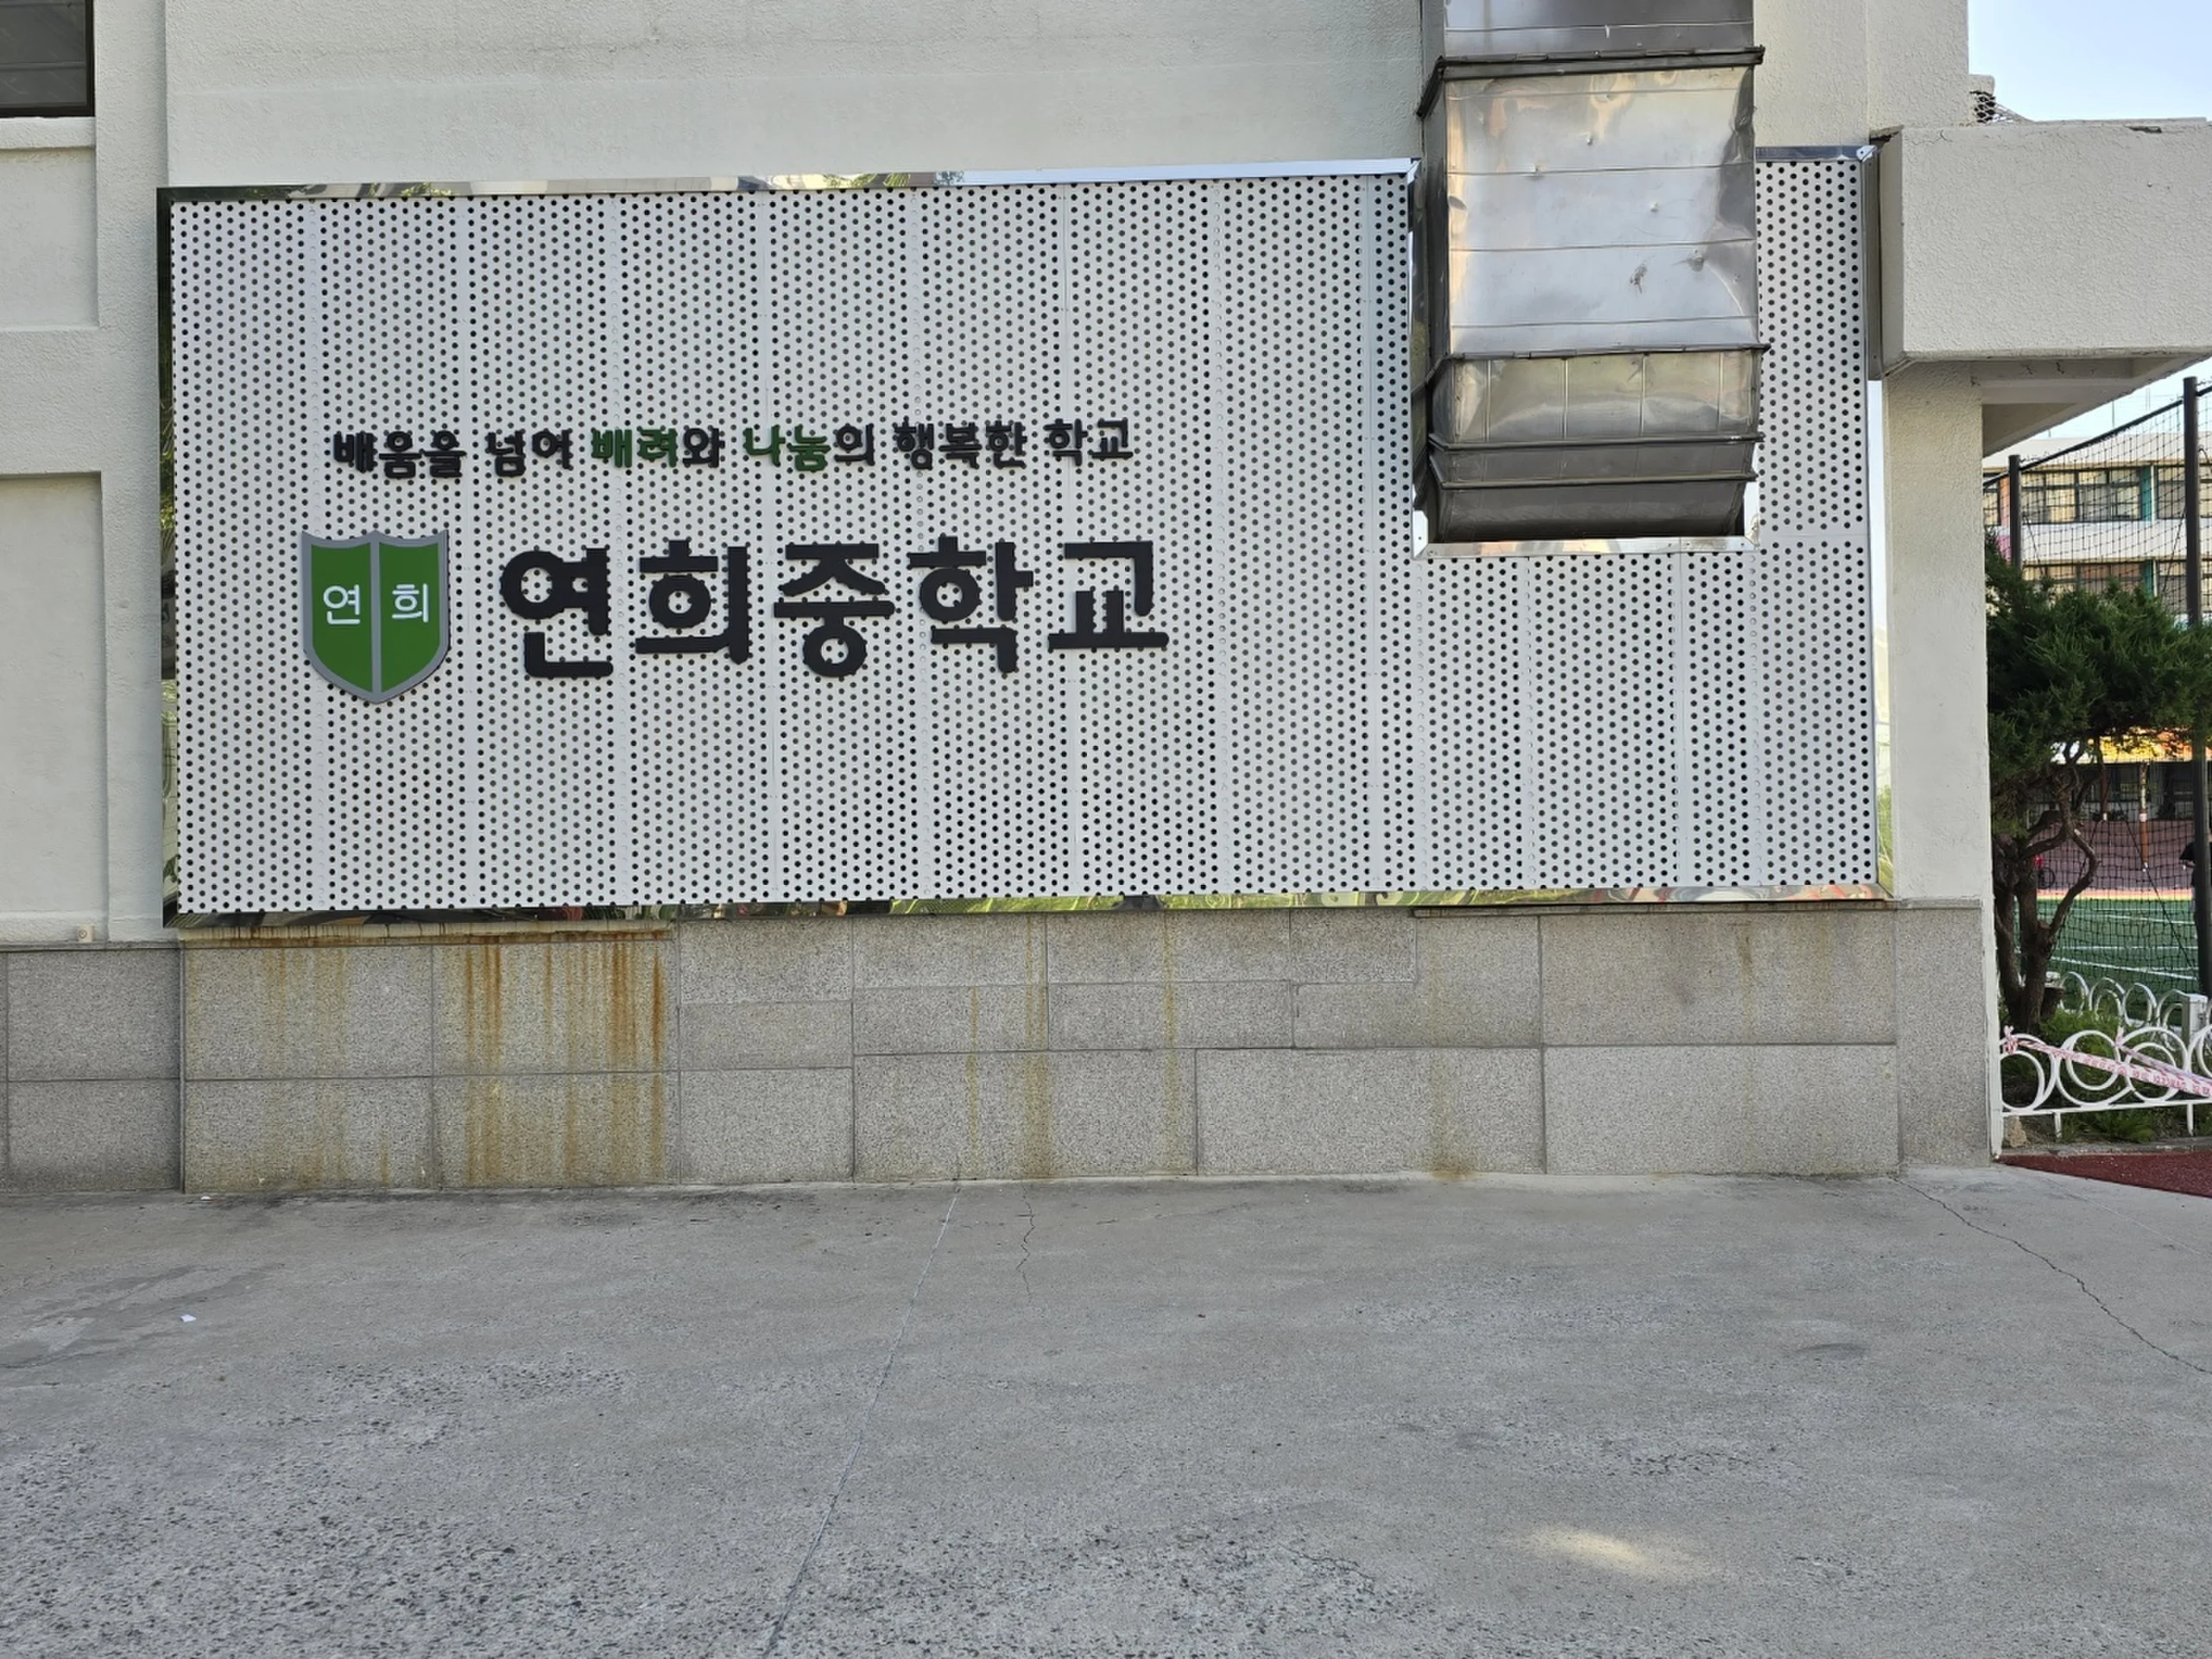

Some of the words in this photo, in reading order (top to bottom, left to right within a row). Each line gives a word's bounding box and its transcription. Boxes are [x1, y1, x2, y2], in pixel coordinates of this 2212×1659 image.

[333, 430, 467, 480] 배움을
[487, 429, 573, 478] 넘어
[591, 427, 725, 469] 배려와
[742, 422, 875, 472] 나눔의
[893, 418, 1028, 469] 행복한
[1043, 417, 1135, 467] 학교
[499, 535, 1169, 678] 연희중학교
